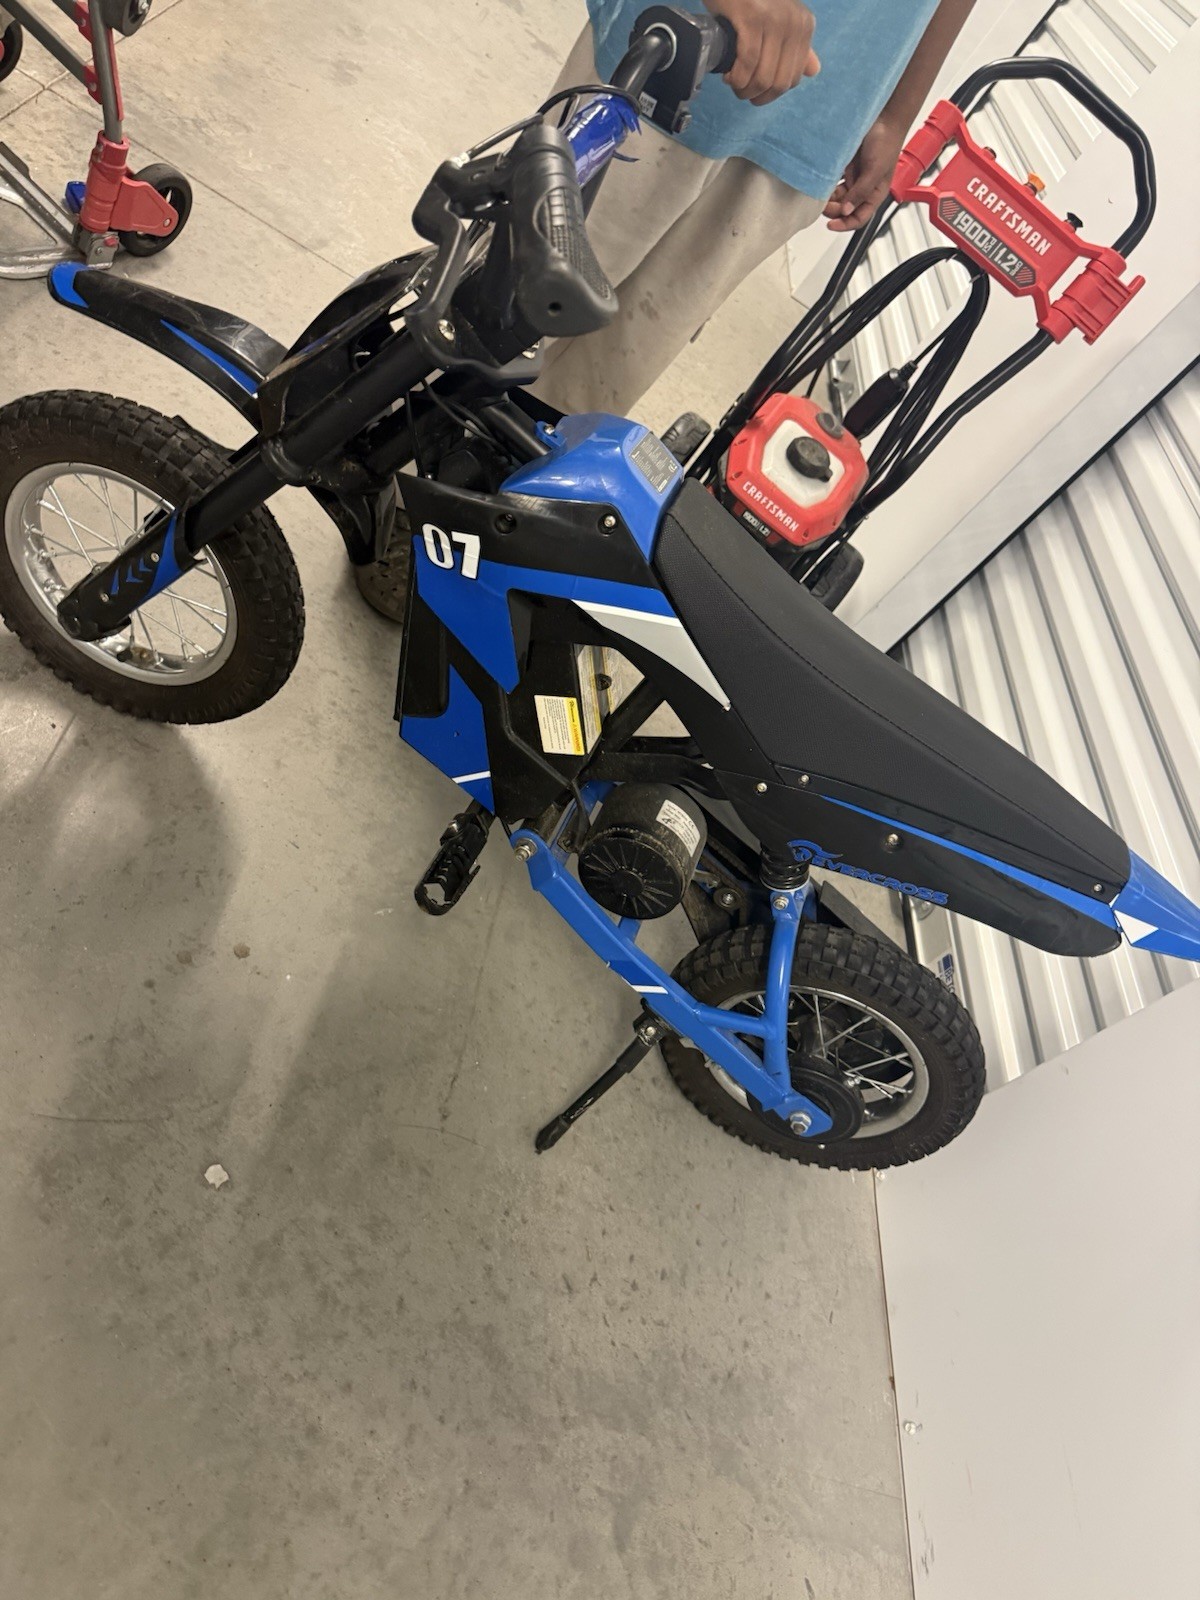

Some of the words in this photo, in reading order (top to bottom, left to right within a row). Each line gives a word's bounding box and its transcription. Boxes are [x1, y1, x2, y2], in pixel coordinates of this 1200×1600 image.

[953, 210, 991, 248] 1900
[982, 236, 997, 253] PSI
[994, 247, 1018, 272] 1.2
[966, 177, 1052, 256] CRAFTSMAN
[742, 480, 800, 533] CRAFTSMAN
[422, 523, 481, 580] 07
[812, 856, 949, 905] EVERCROSS
